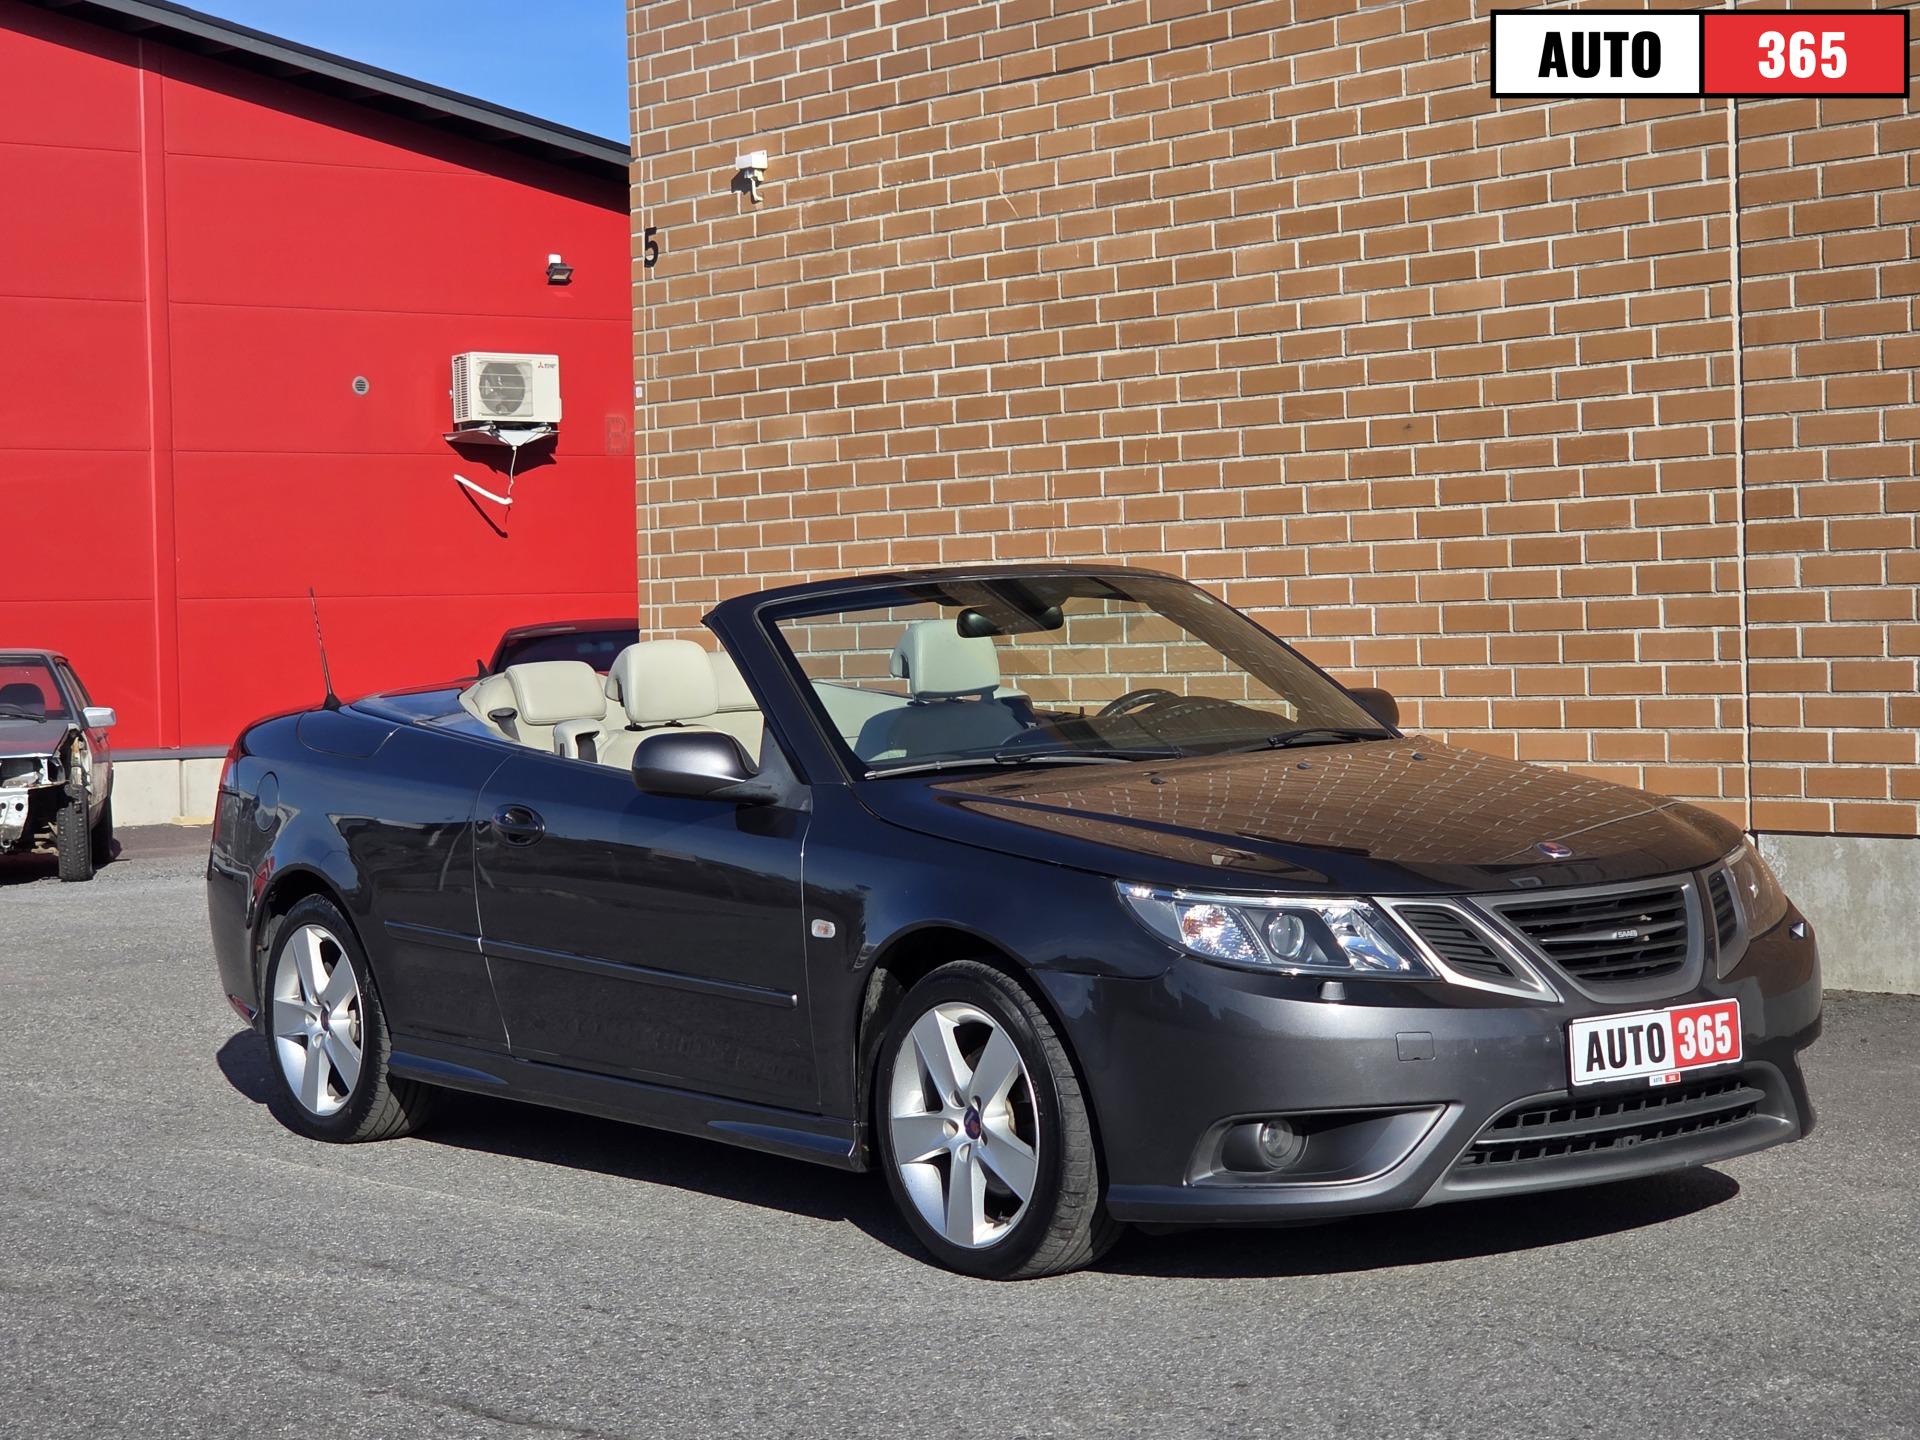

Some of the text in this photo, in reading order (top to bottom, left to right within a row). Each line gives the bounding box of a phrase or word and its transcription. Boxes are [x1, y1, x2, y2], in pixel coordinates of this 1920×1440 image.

[644, 226, 658, 268] 5
[1586, 1012, 1732, 1073] AUTO 365
